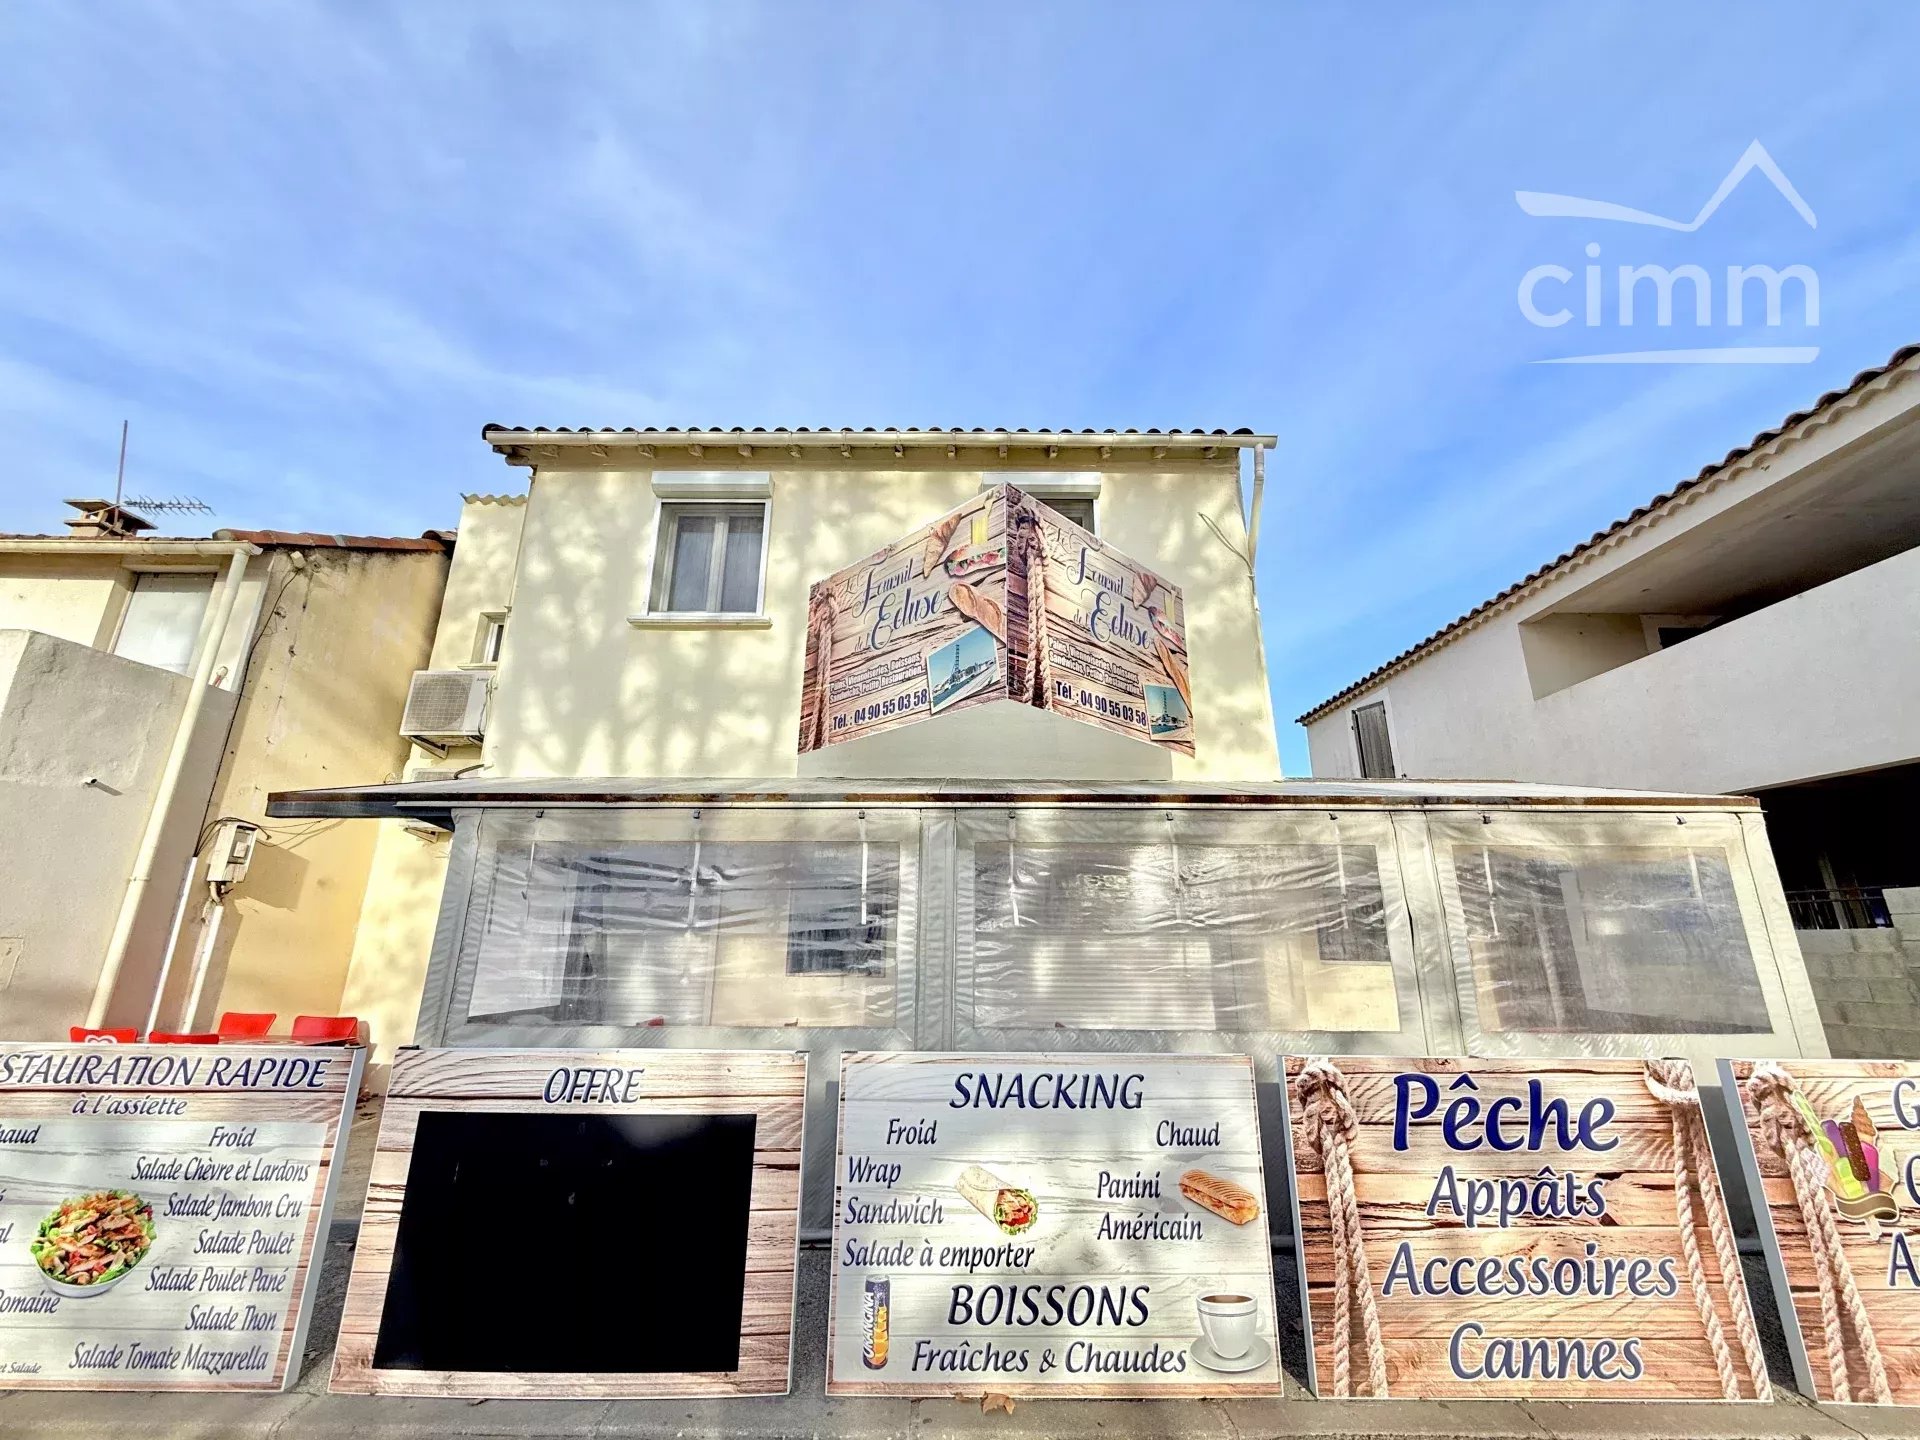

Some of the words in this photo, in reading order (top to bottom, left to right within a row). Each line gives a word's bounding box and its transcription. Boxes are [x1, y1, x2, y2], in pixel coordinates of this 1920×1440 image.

[854, 708, 866, 723] 04
[868, 704, 880, 720] 90
[883, 699, 896, 715] 55
[898, 694, 911, 711] 03
[914, 688, 927, 707] 58
[1081, 690, 1093, 708] 04
[1095, 695, 1107, 713] 90
[1109, 700, 1121, 717] 55
[1123, 705, 1134, 722] 03
[1135, 710, 1147, 726] 58
[0, 1053, 201, 1087] STAURATION
[206, 1057, 331, 1088] RAPIDE
[544, 1067, 644, 1103] OFFRE
[72, 1094, 87, 1115] à
[92, 1095, 187, 1116] l'assiette
[949, 1072, 1144, 1110] SNACKING
[1393, 1073, 1619, 1151] Pêche
[208, 1126, 257, 1147] Froid
[886, 1118, 937, 1146] Froid
[1156, 1120, 1220, 1148] Chaud
[131, 1156, 182, 1180] Salade
[184, 1156, 233, 1181] Chèvre
[235, 1160, 251, 1181] et
[252, 1157, 310, 1182] Lardons
[849, 1156, 901, 1184] Wrap
[1097, 1171, 1161, 1199] Panini
[1426, 1165, 1606, 1227] Appâts
[163, 1192, 215, 1217] Salade
[212, 1193, 273, 1221] Jambon
[275, 1193, 303, 1218] Cru
[844, 1197, 944, 1225] Sandwich
[193, 1228, 245, 1254] Salade
[247, 1229, 295, 1254] Poulet
[1097, 1212, 1203, 1241] Américain
[842, 1239, 914, 1268] Salade
[922, 1238, 934, 1267] à
[939, 1243, 1035, 1274] emporter
[1382, 1242, 1678, 1297] Accessoires
[145, 1265, 198, 1291] Salade
[199, 1266, 248, 1292] Poulet
[248, 1266, 289, 1292] Pané
[185, 1304, 238, 1330] Salade
[241, 1304, 277, 1331] Thon
[947, 1285, 1150, 1327] BOISSONS
[69, 1341, 123, 1369] Salade
[125, 1342, 180, 1370] Tomate
[181, 1342, 269, 1375] Mazzarella
[911, 1340, 1029, 1374] Fraîches
[1039, 1351, 1057, 1373] &
[1064, 1341, 1187, 1374] Chaudes
[1449, 1322, 1643, 1381] Cannes
[8, 1361, 41, 1374] Salade
